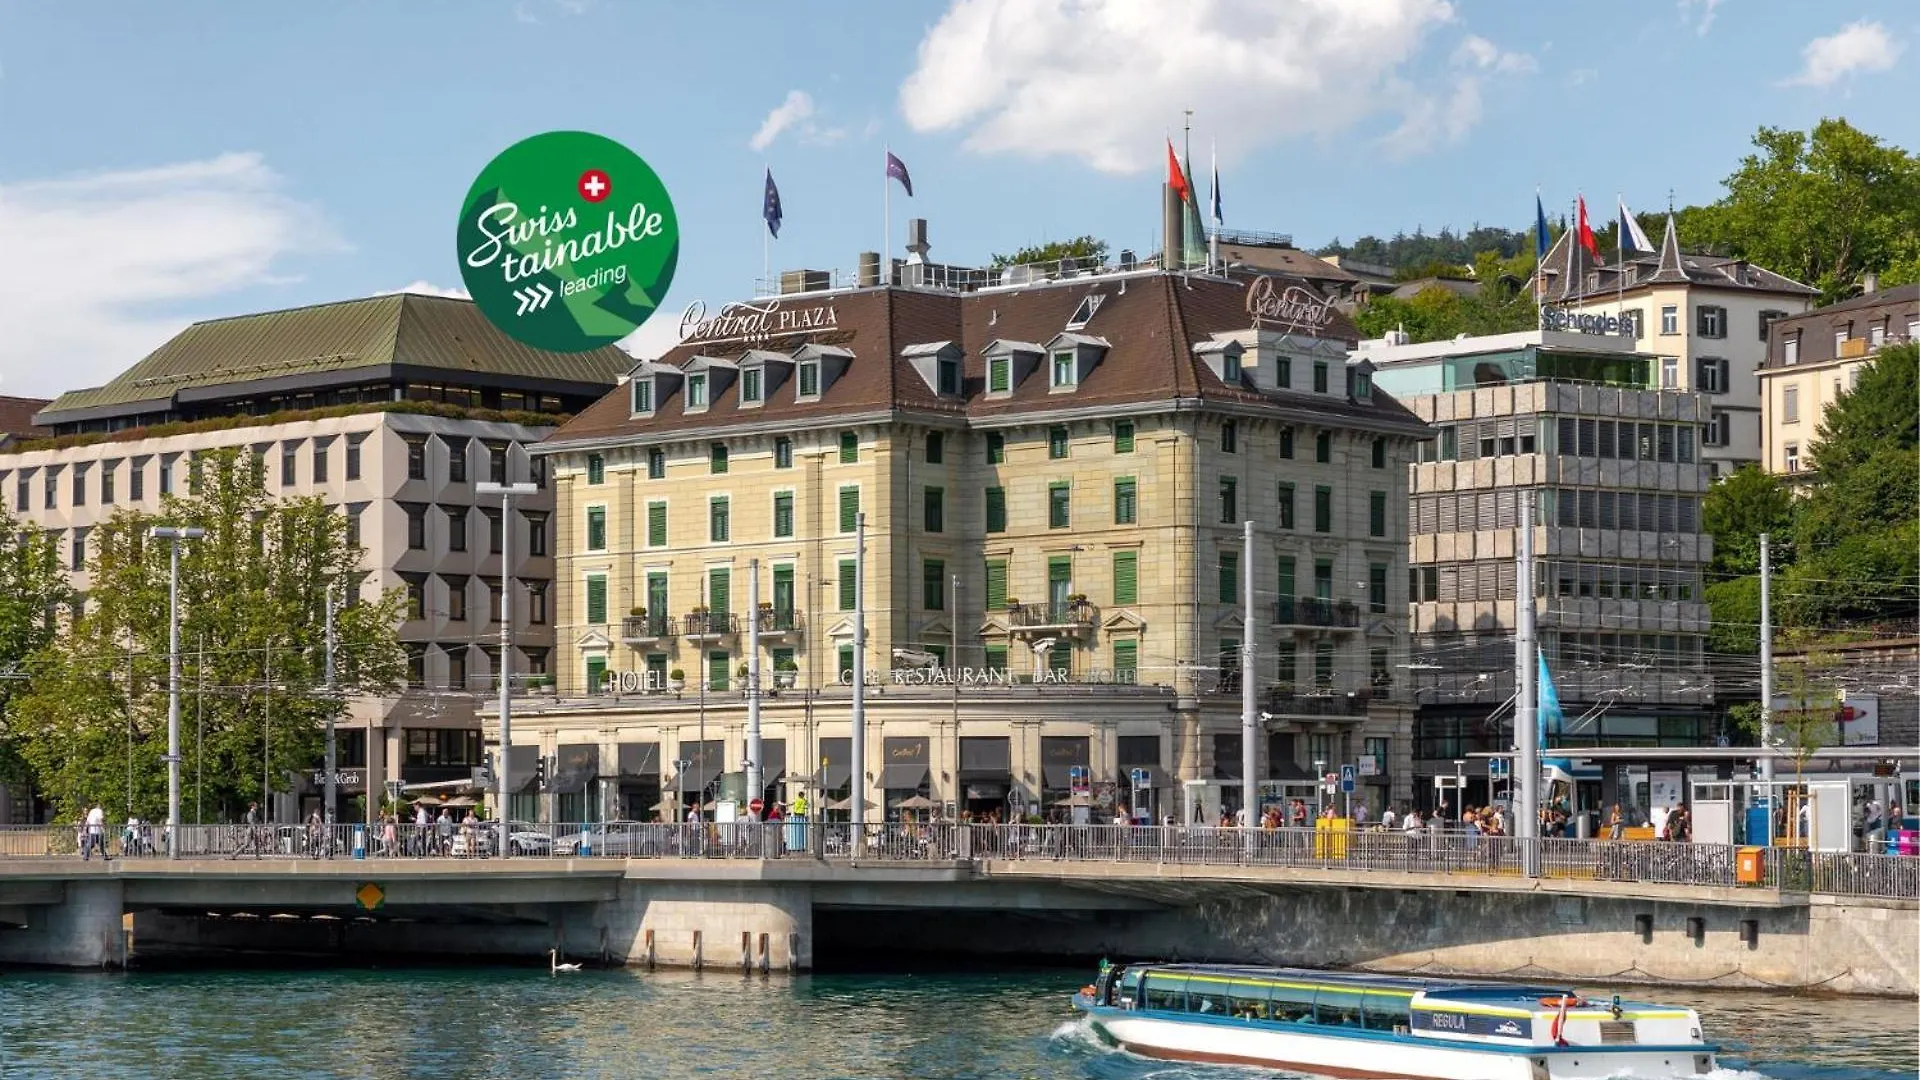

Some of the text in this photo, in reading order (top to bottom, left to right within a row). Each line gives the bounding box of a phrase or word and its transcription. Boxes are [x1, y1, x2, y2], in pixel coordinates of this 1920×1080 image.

[679, 299, 838, 339] Central PLAZA
[609, 670, 669, 692] HOTEL
[895, 667, 1016, 684] RESTAURANT
[1033, 667, 1068, 684] BAR
[1433, 1013, 1466, 1030] REGULA
